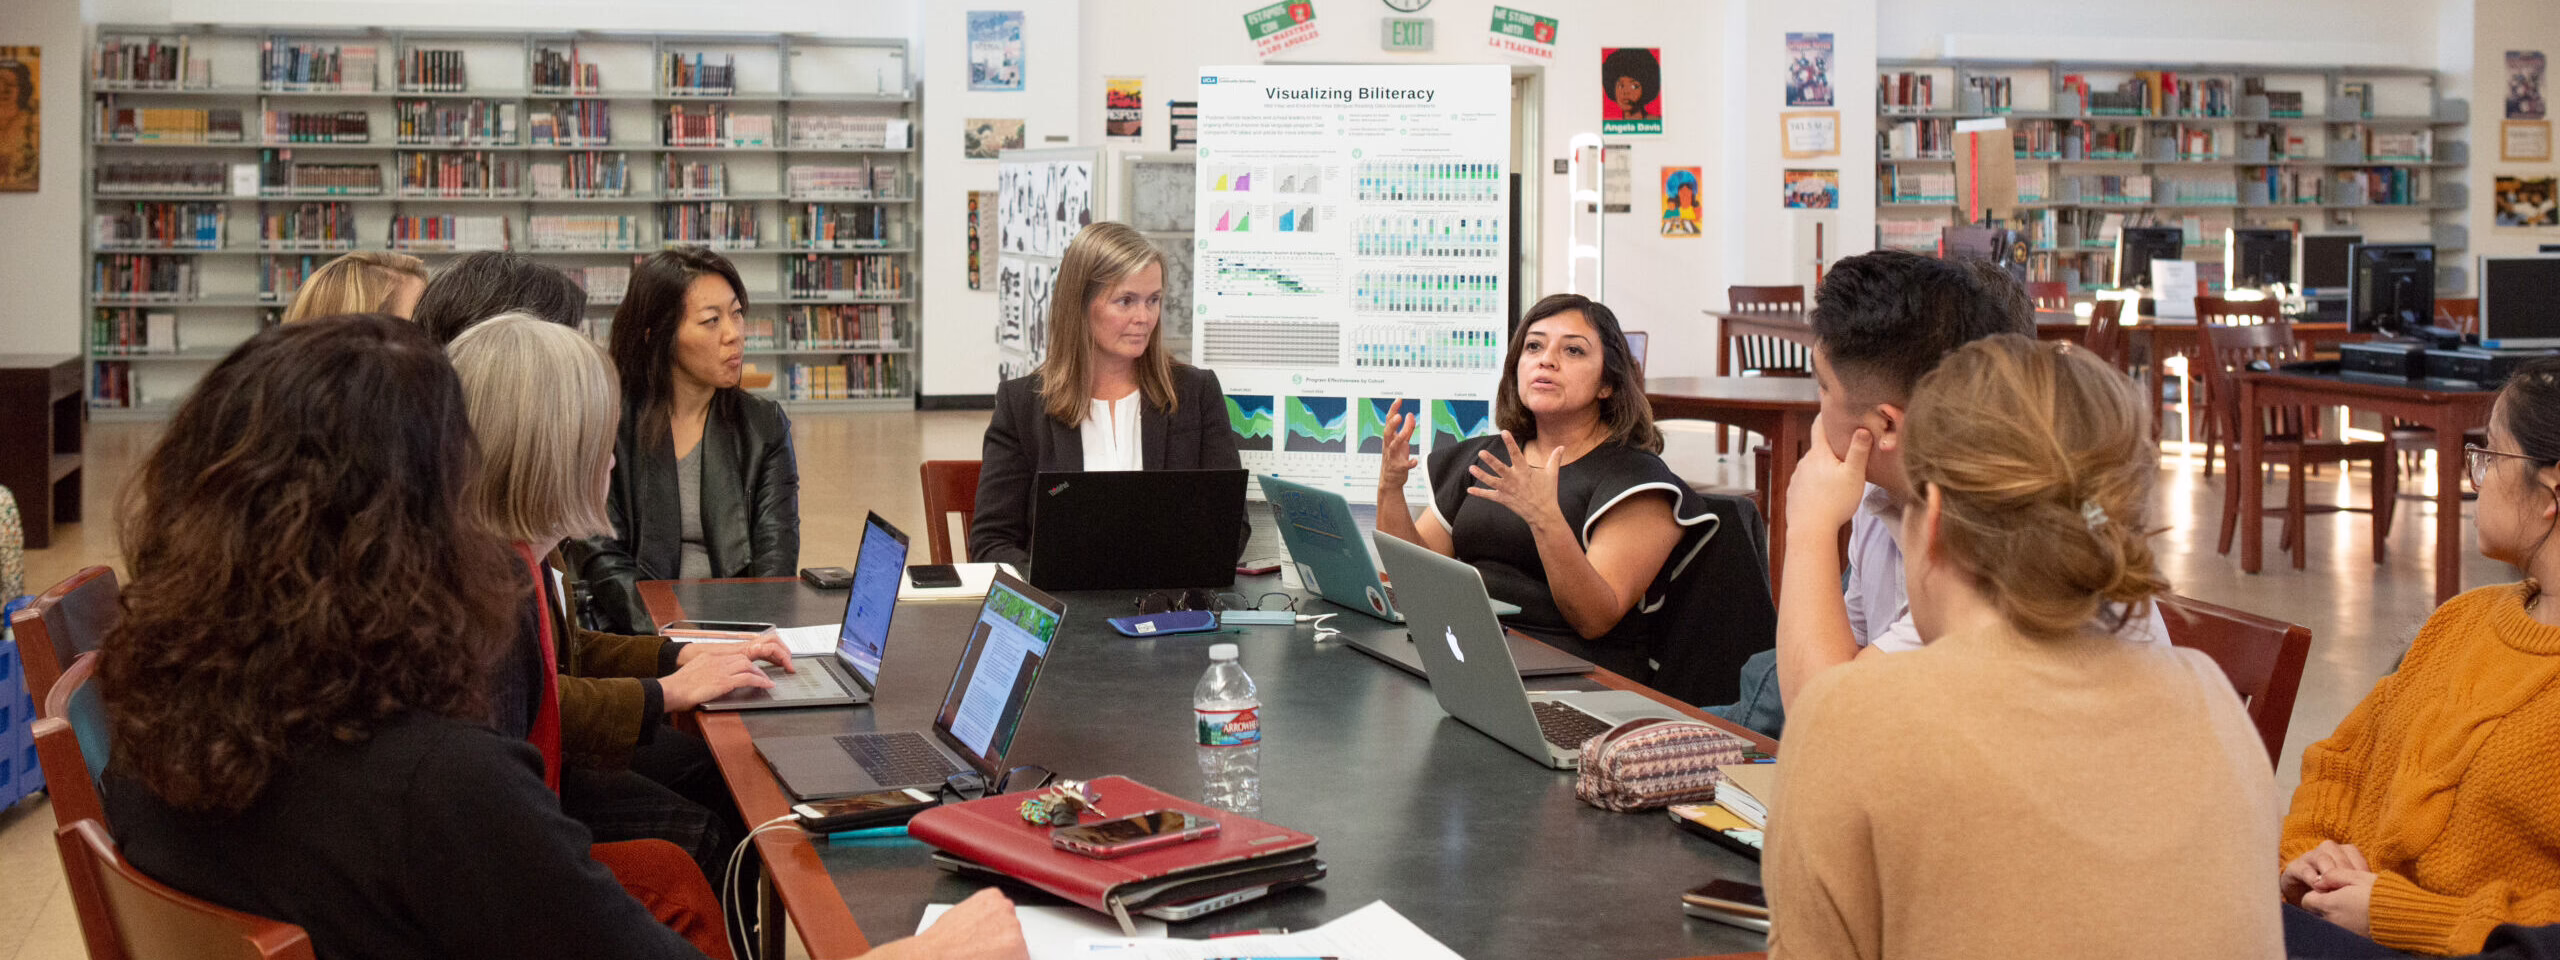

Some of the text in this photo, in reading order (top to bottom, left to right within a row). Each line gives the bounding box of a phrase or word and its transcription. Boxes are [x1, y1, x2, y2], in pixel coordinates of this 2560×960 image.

[1495, 8, 1535, 27] WE STAND
[1393, 21, 1424, 47] EXIT
[1503, 21, 1523, 36] WITH
[1489, 37, 1553, 59] LA TEACHERS
[1266, 87, 1435, 102] Visualizing Biliteracy
[1606, 122, 1661, 134] Angela Davis
[1306, 376, 1327, 384] Program
